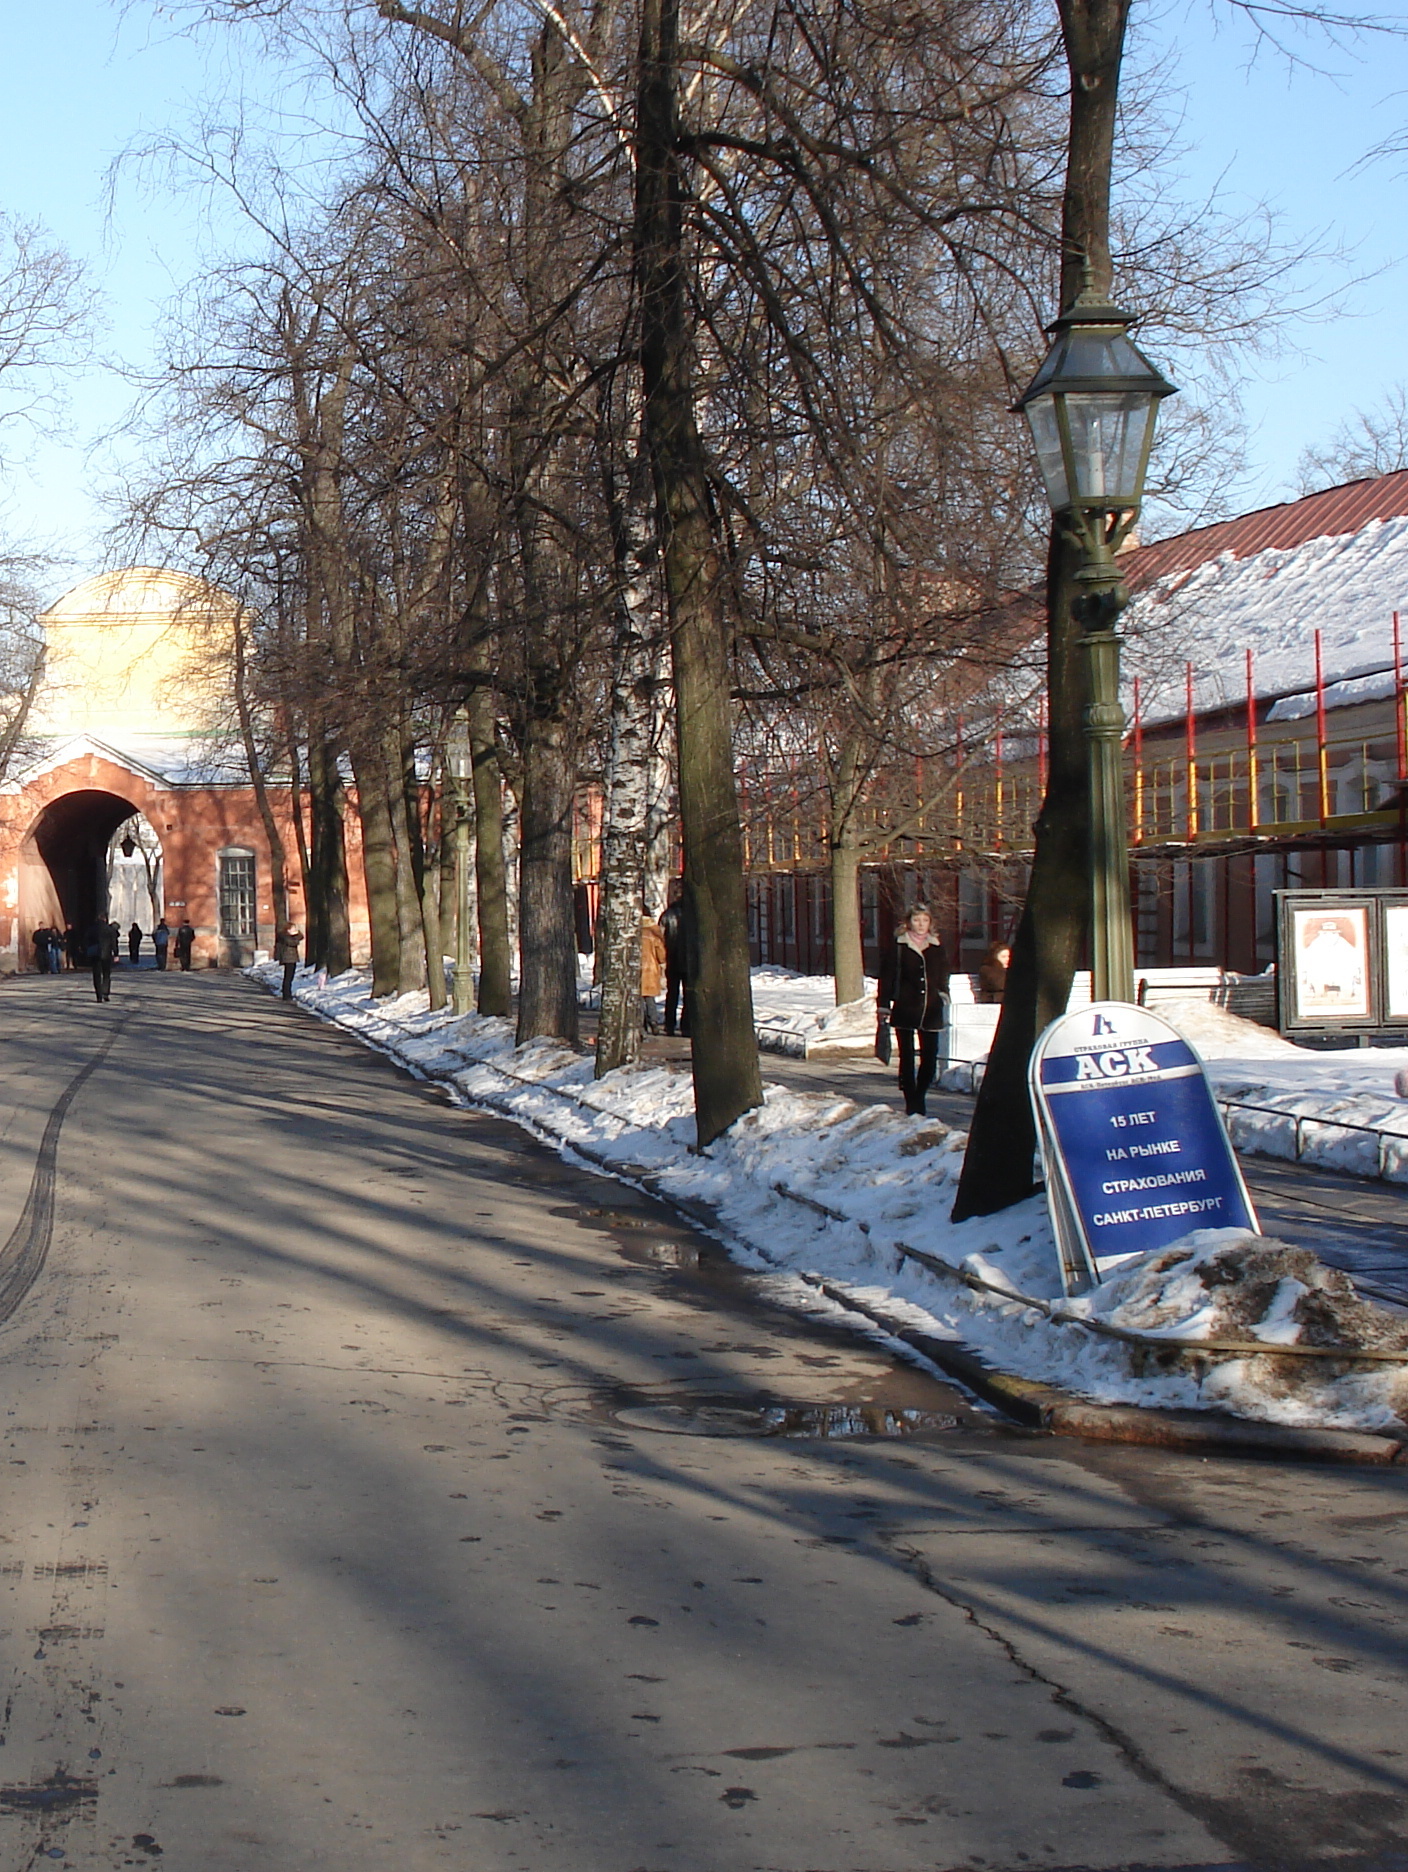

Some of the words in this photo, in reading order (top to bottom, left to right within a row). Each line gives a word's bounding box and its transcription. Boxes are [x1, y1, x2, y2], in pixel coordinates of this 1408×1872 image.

[1074, 1042, 1118, 1053] СТРАХОВАЯ
[1119, 1038, 1149, 1048] ГРУППА
[1075, 1046, 1159, 1080] АСК
[1109, 1115, 1127, 1128] 15
[1129, 1111, 1156, 1126] ЛЕТ
[1106, 1147, 1128, 1161] НА
[1129, 1140, 1181, 1158] РЫНКЕ
[1102, 1169, 1206, 1194] СТРАХОВАНИЯ
[1093, 1197, 1222, 1226] САНКТ-ПЕТЕРБУРГ
